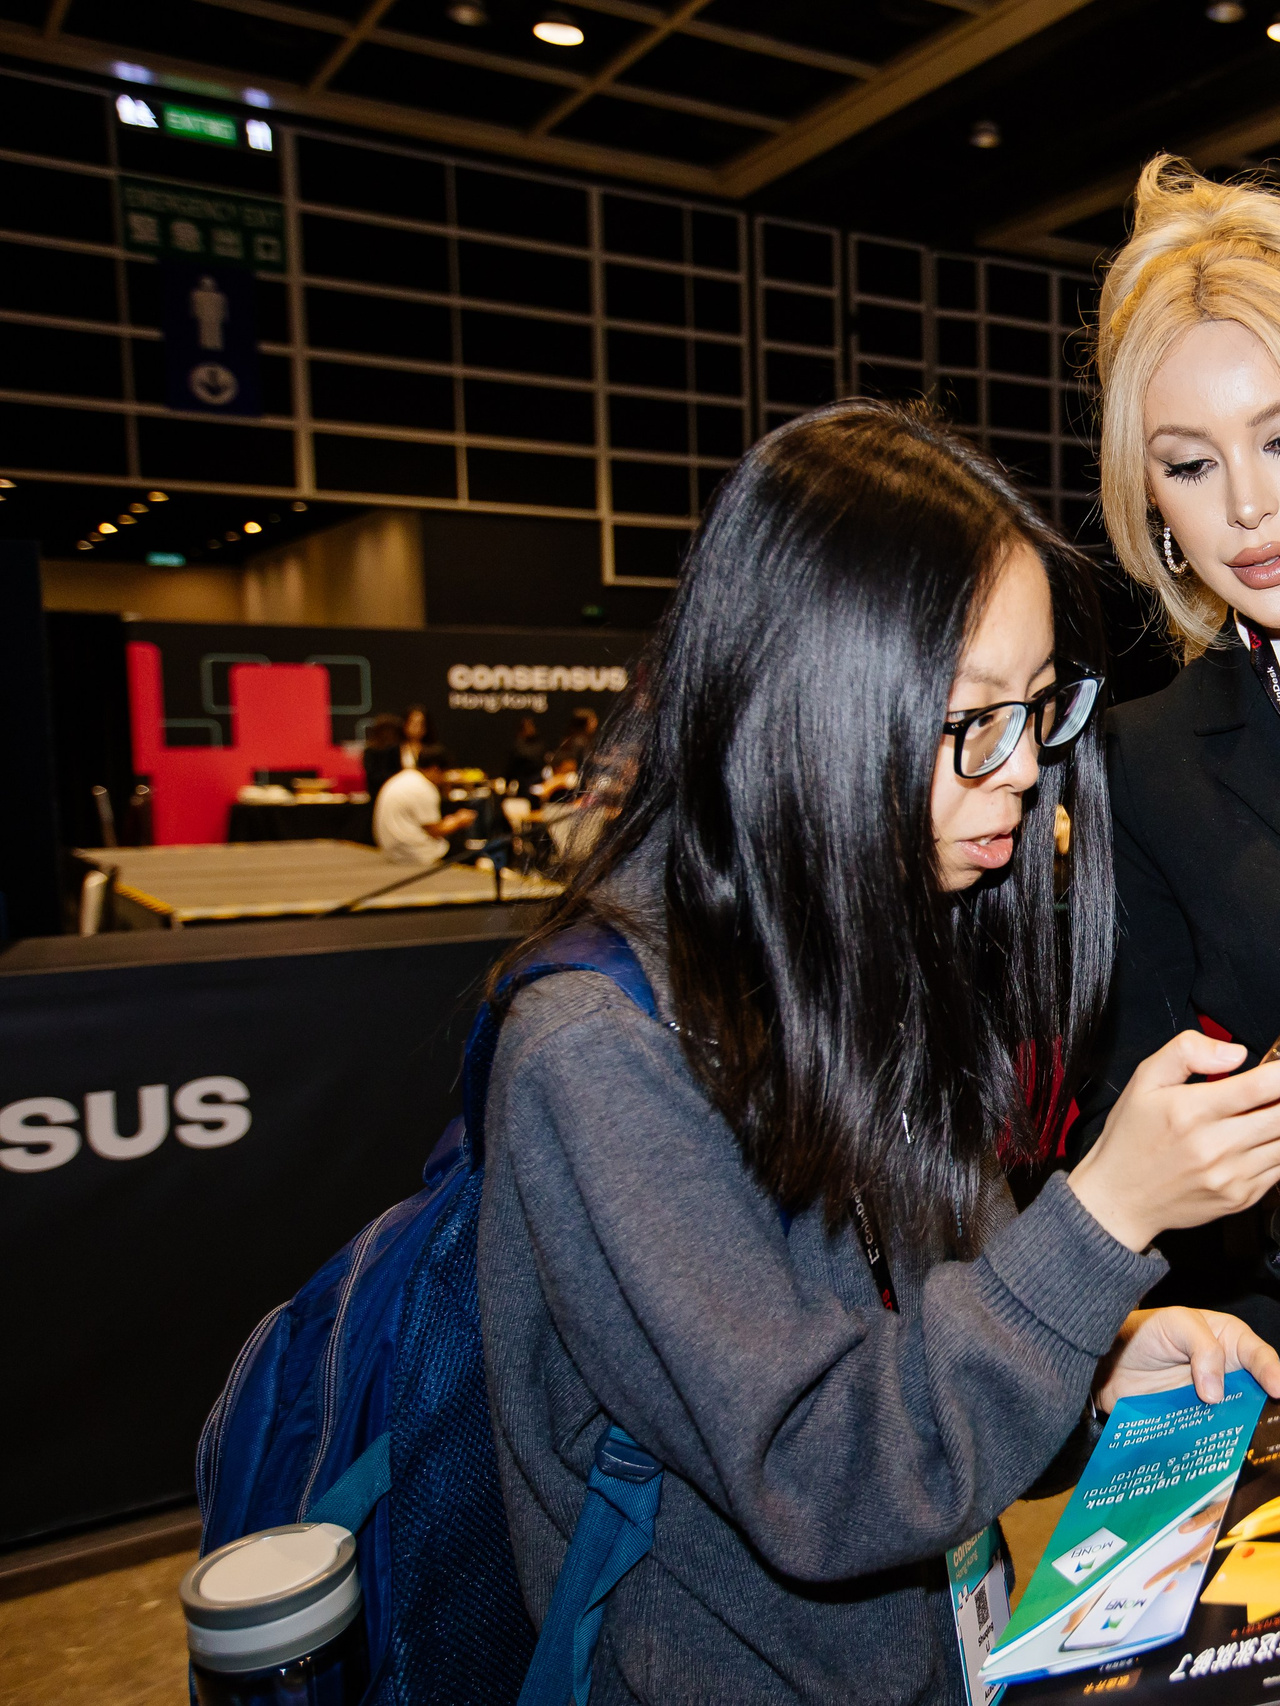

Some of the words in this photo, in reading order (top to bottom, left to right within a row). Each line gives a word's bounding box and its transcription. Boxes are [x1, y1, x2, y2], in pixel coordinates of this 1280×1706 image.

[1165, 1403, 1203, 1420] Assets
[1173, 1408, 1211, 1425] Digital
[1207, 1413, 1215, 1422] A
[1117, 1414, 1162, 1430] Finance
[1125, 1420, 1171, 1438] Banking
[1179, 1418, 1203, 1431] New
[1113, 1431, 1122, 1441] &
[1123, 1426, 1175, 1448] Standard
[1195, 1424, 1244, 1447] Assets
[1108, 1441, 1120, 1450] in
[1182, 1436, 1239, 1461] Finance
[1166, 1456, 1177, 1467] &
[1172, 1447, 1234, 1473] Bridging
[1110, 1461, 1161, 1484] Digital
[1185, 1459, 1230, 1481] Monfi
[1083, 1472, 1165, 1500] Traditional
[1129, 1474, 1180, 1499] Digital
[1086, 1492, 1125, 1510] Bank
[1071, 1540, 1114, 1559] MONFI
[1104, 1598, 1147, 1611] MONFI
